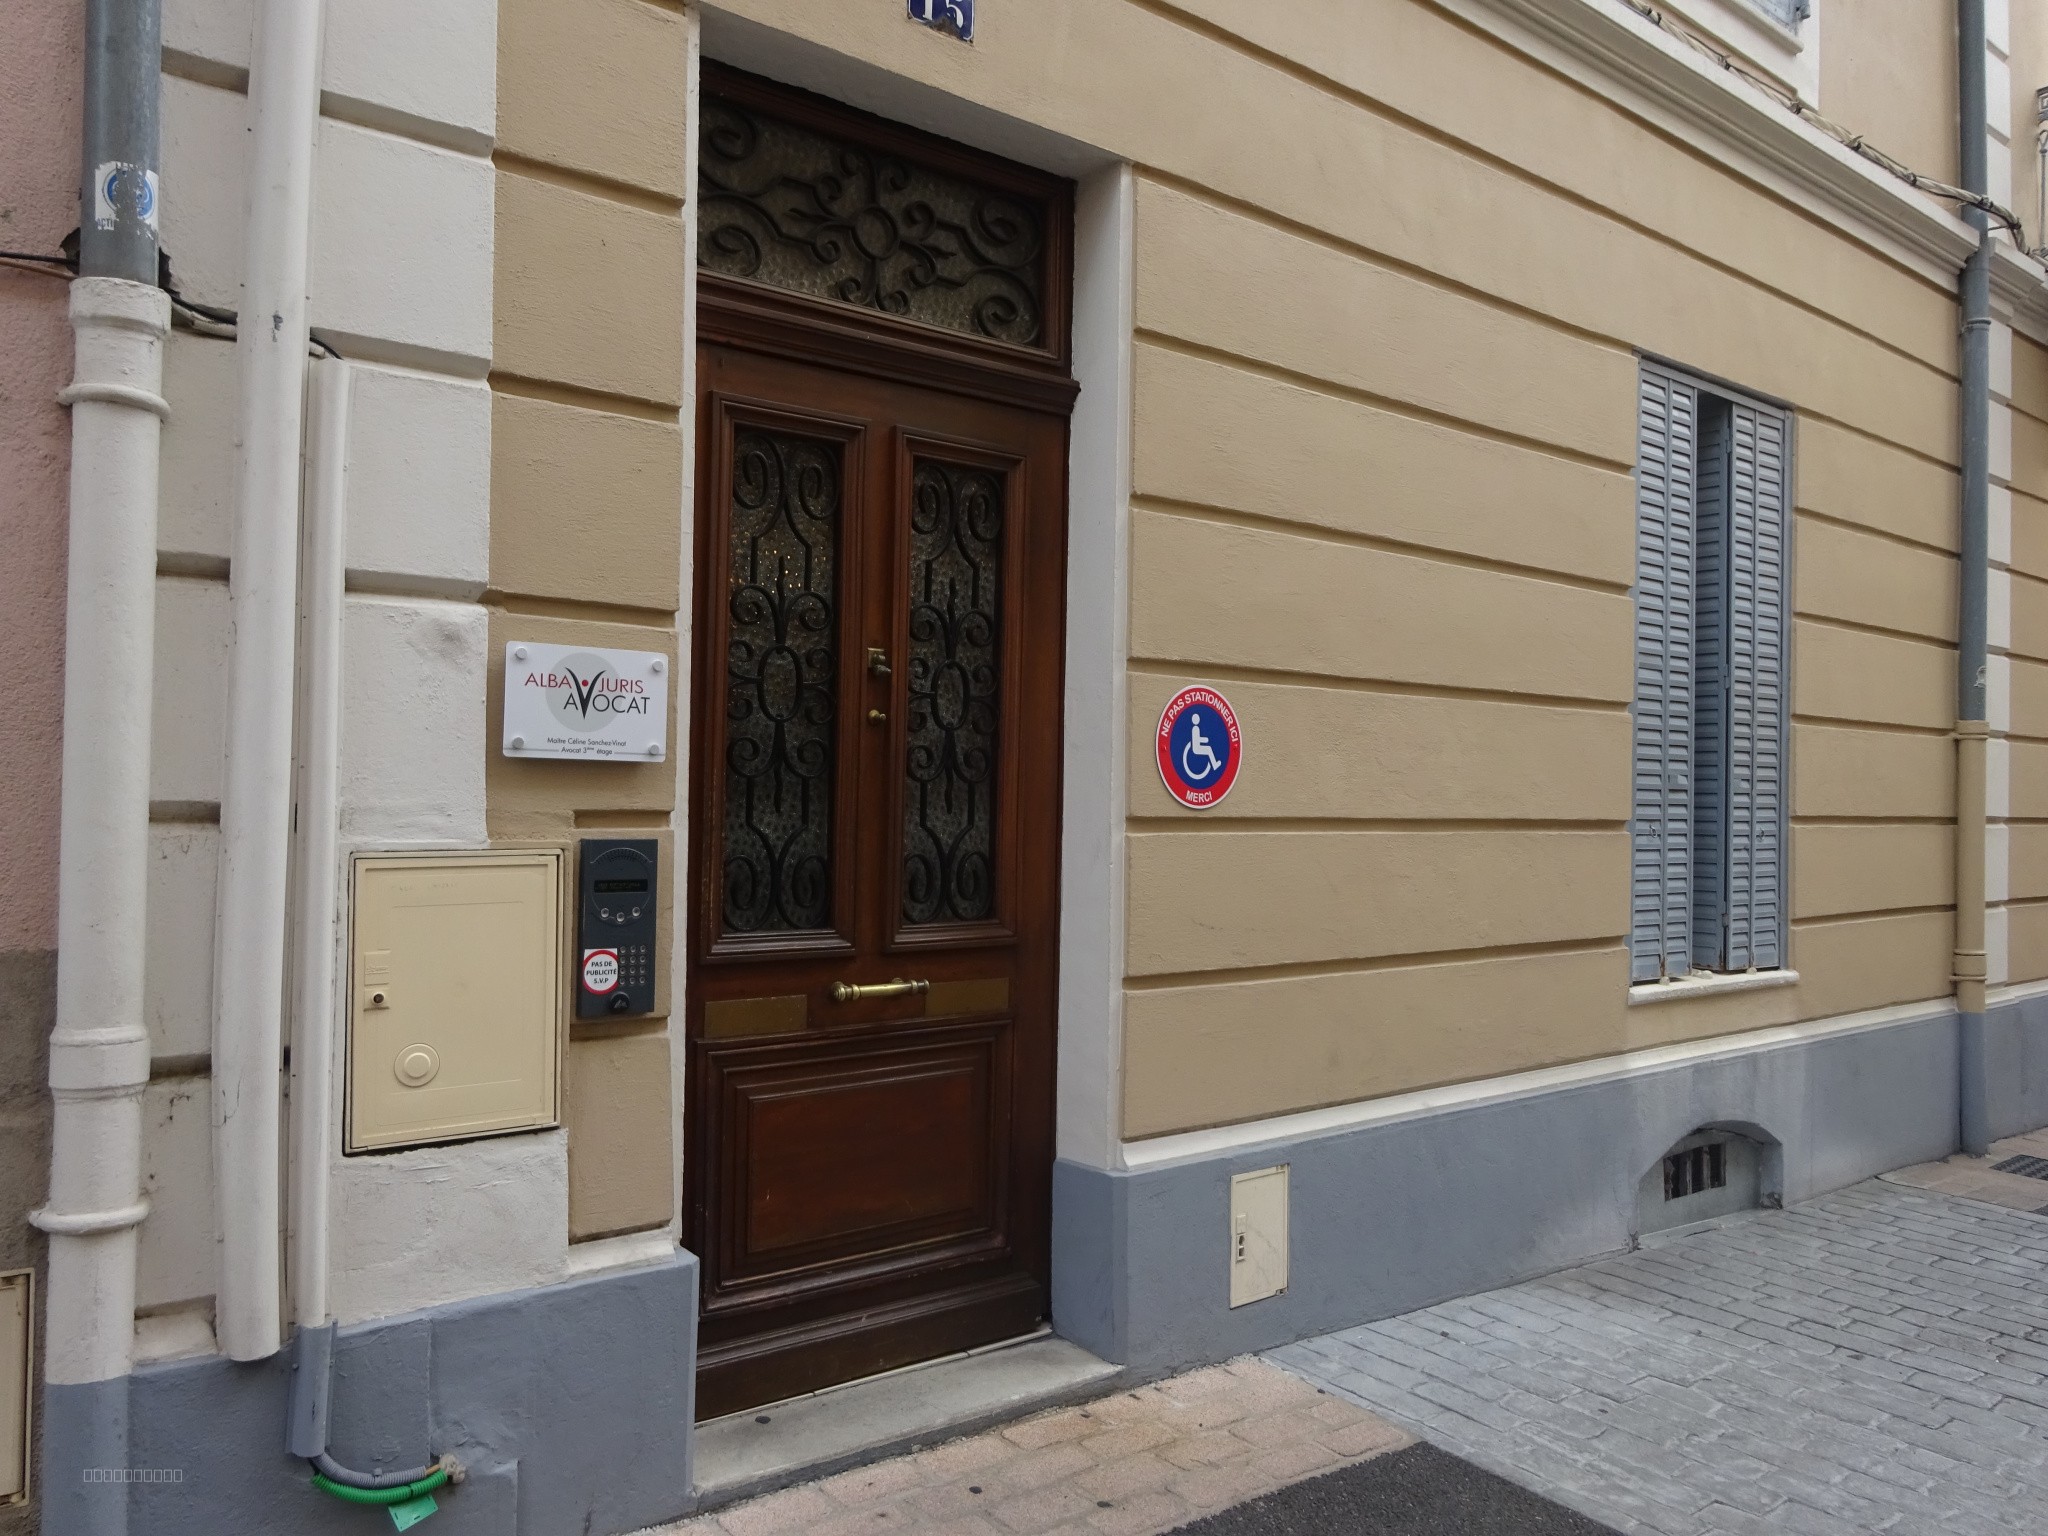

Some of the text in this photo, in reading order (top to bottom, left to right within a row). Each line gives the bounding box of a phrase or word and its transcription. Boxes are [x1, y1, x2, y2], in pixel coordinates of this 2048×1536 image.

[525, 673, 644, 694] ALBA JURIS
[1161, 692, 1239, 742] NE PAS STATIONNER ICI
[597, 748, 613, 756] étage
[1185, 790, 1212, 803] MERCI
[586, 968, 617, 976] PUBLICITÉ
